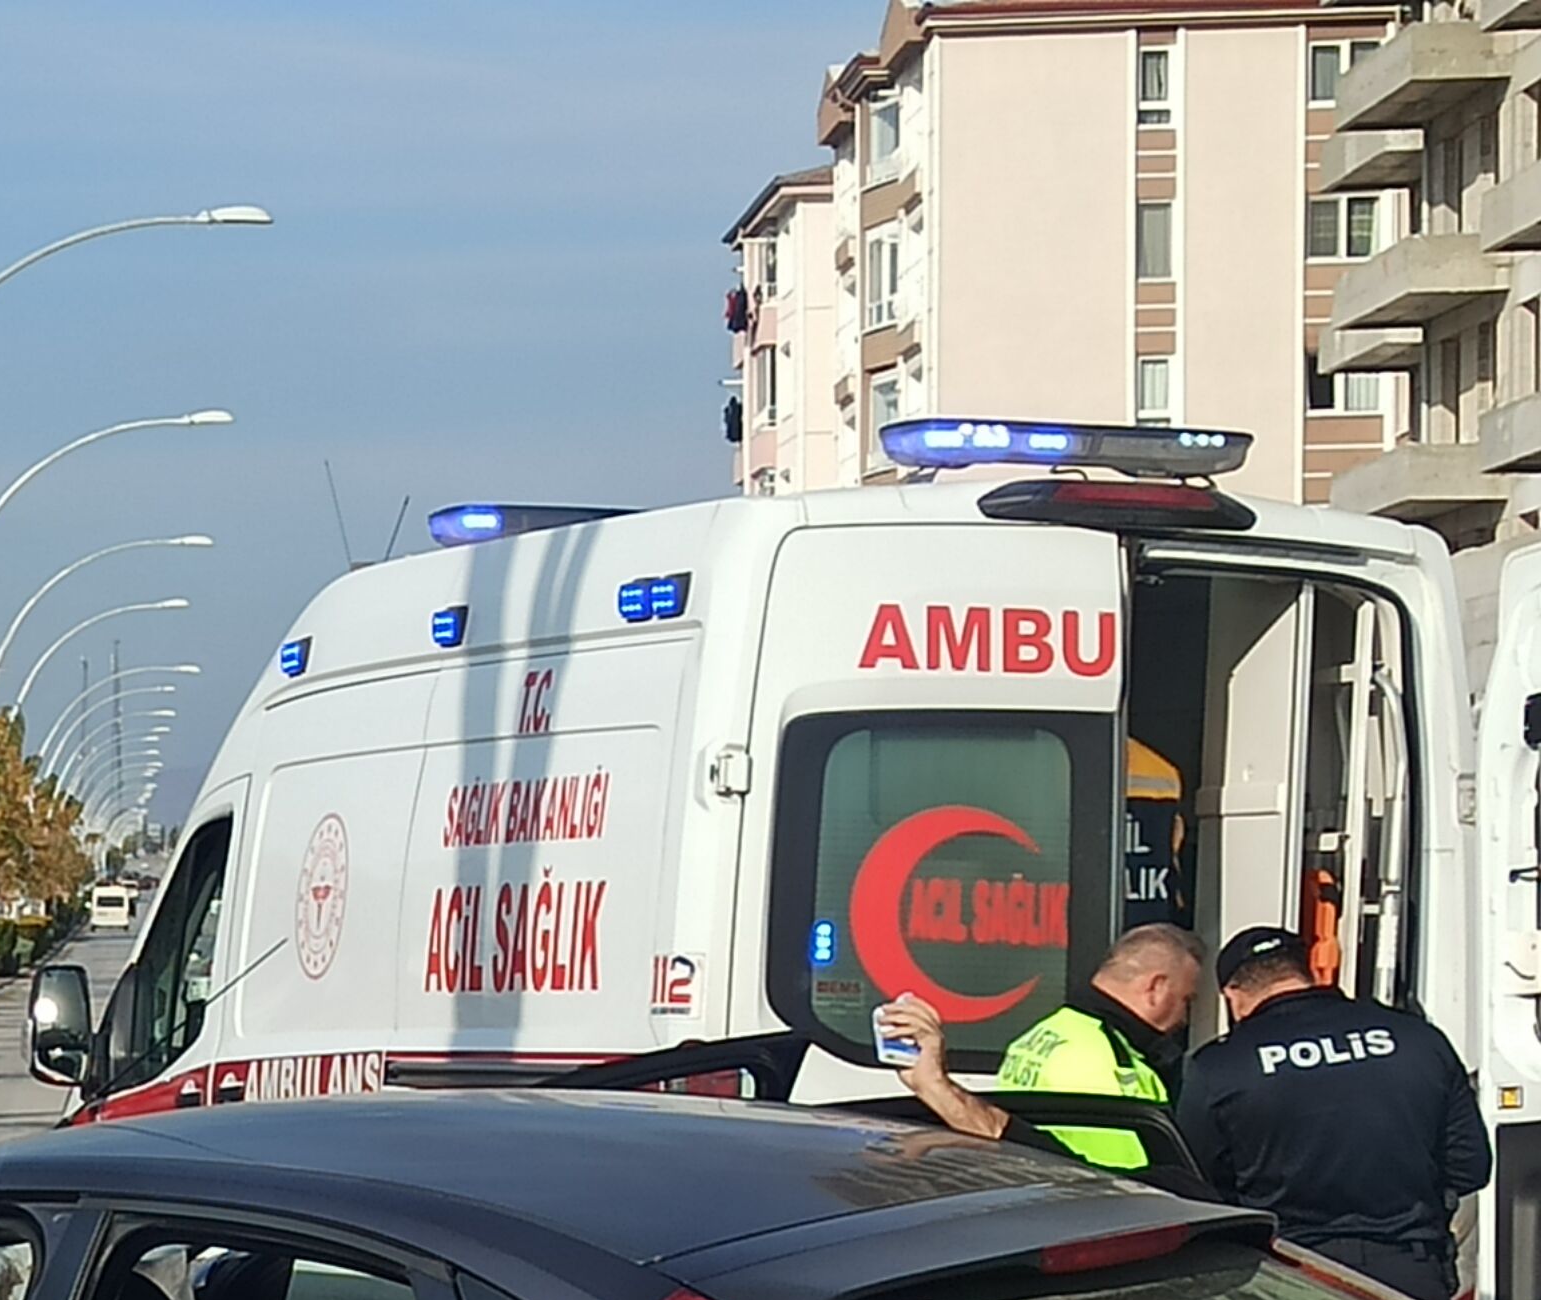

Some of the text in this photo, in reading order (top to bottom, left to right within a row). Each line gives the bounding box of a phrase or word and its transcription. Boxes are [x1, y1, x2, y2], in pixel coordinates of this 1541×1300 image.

[858, 603, 1116, 677] AMBU
[519, 668, 553, 734] T.C.
[443, 765, 610, 848] SAĞLIK BAKANLIĞI
[1124, 866, 1169, 900] LIK
[492, 864, 607, 993] SAĞLIK
[652, 954, 696, 1003] 112
